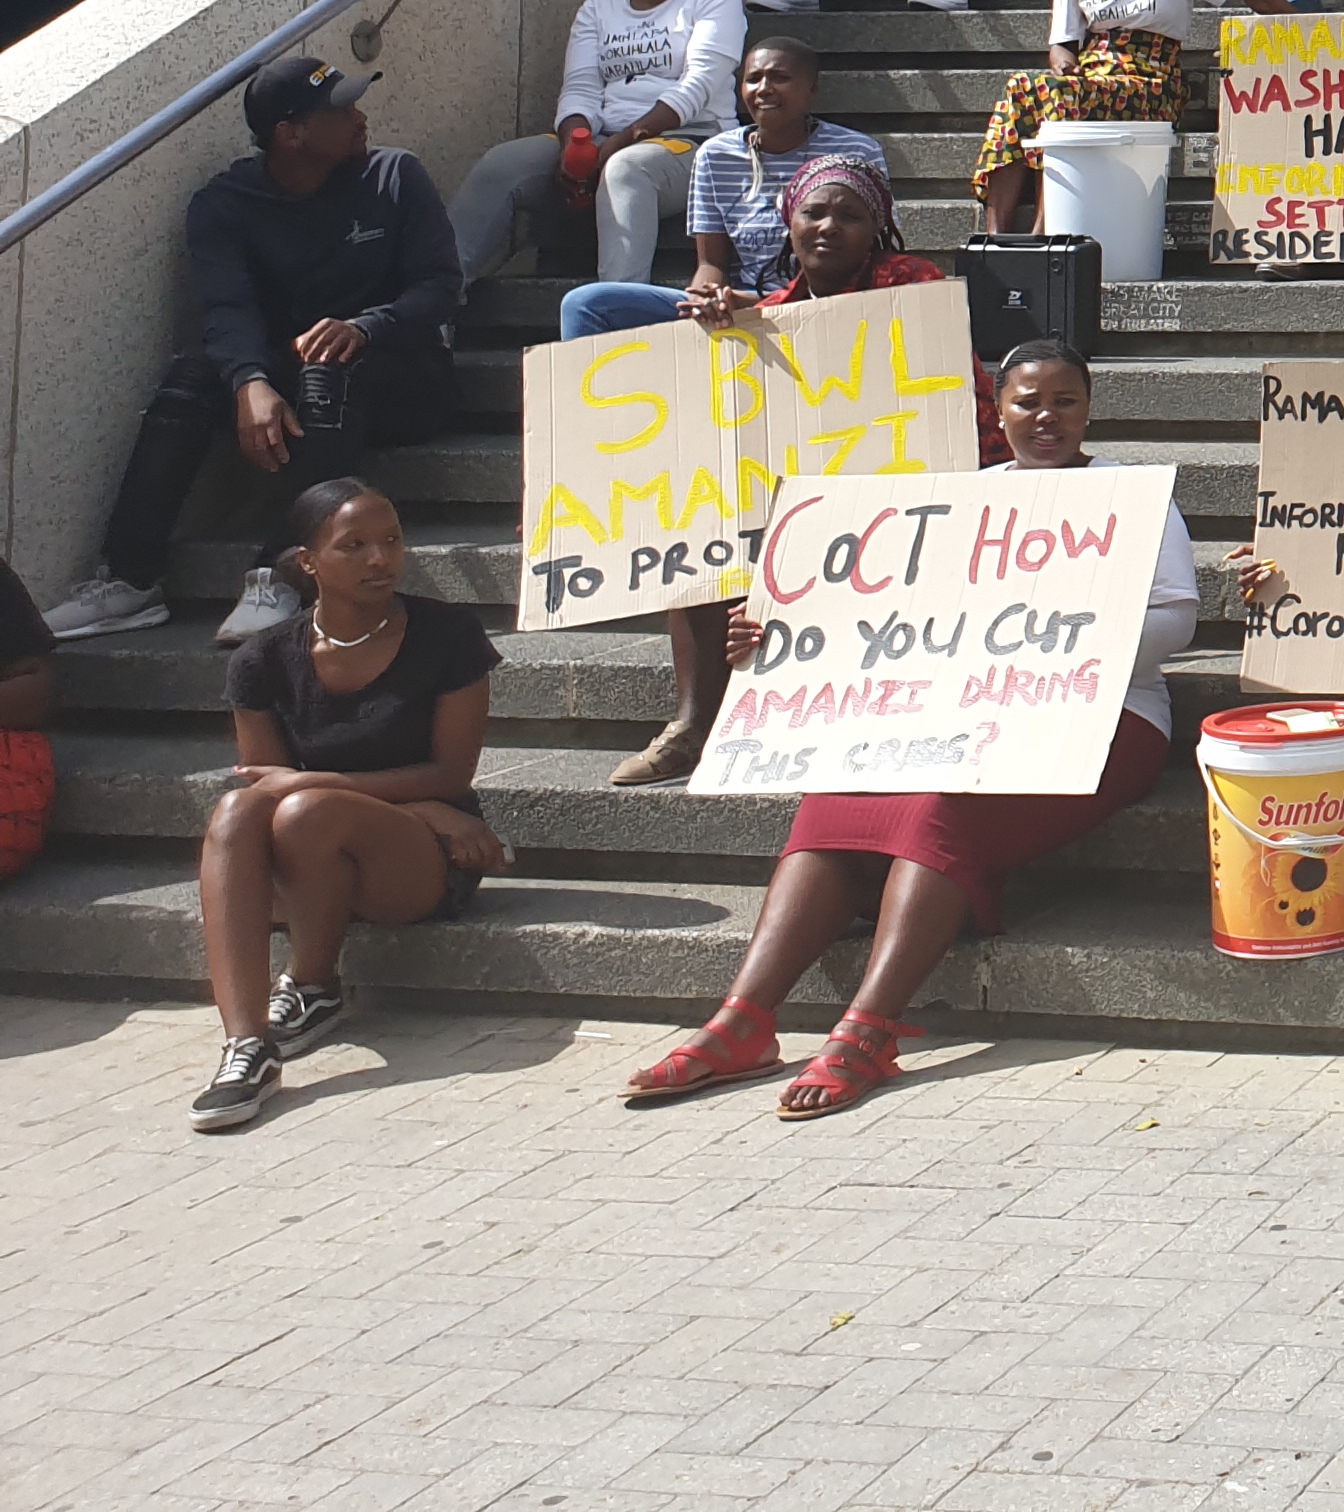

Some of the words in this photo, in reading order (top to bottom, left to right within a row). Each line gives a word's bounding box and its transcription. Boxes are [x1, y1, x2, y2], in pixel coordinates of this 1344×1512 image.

[1149, 302, 1182, 317] CITY
[528, 409, 926, 556] AMANZI
[969, 505, 1117, 584] HOW
[532, 554, 605, 614] TO
[753, 618, 827, 675] DO
[856, 610, 967, 669] YOU
[984, 603, 1097, 655] CUT
[718, 677, 933, 738] AMANZI
[959, 658, 1101, 708] DURING
[715, 739, 818, 787] THIS
